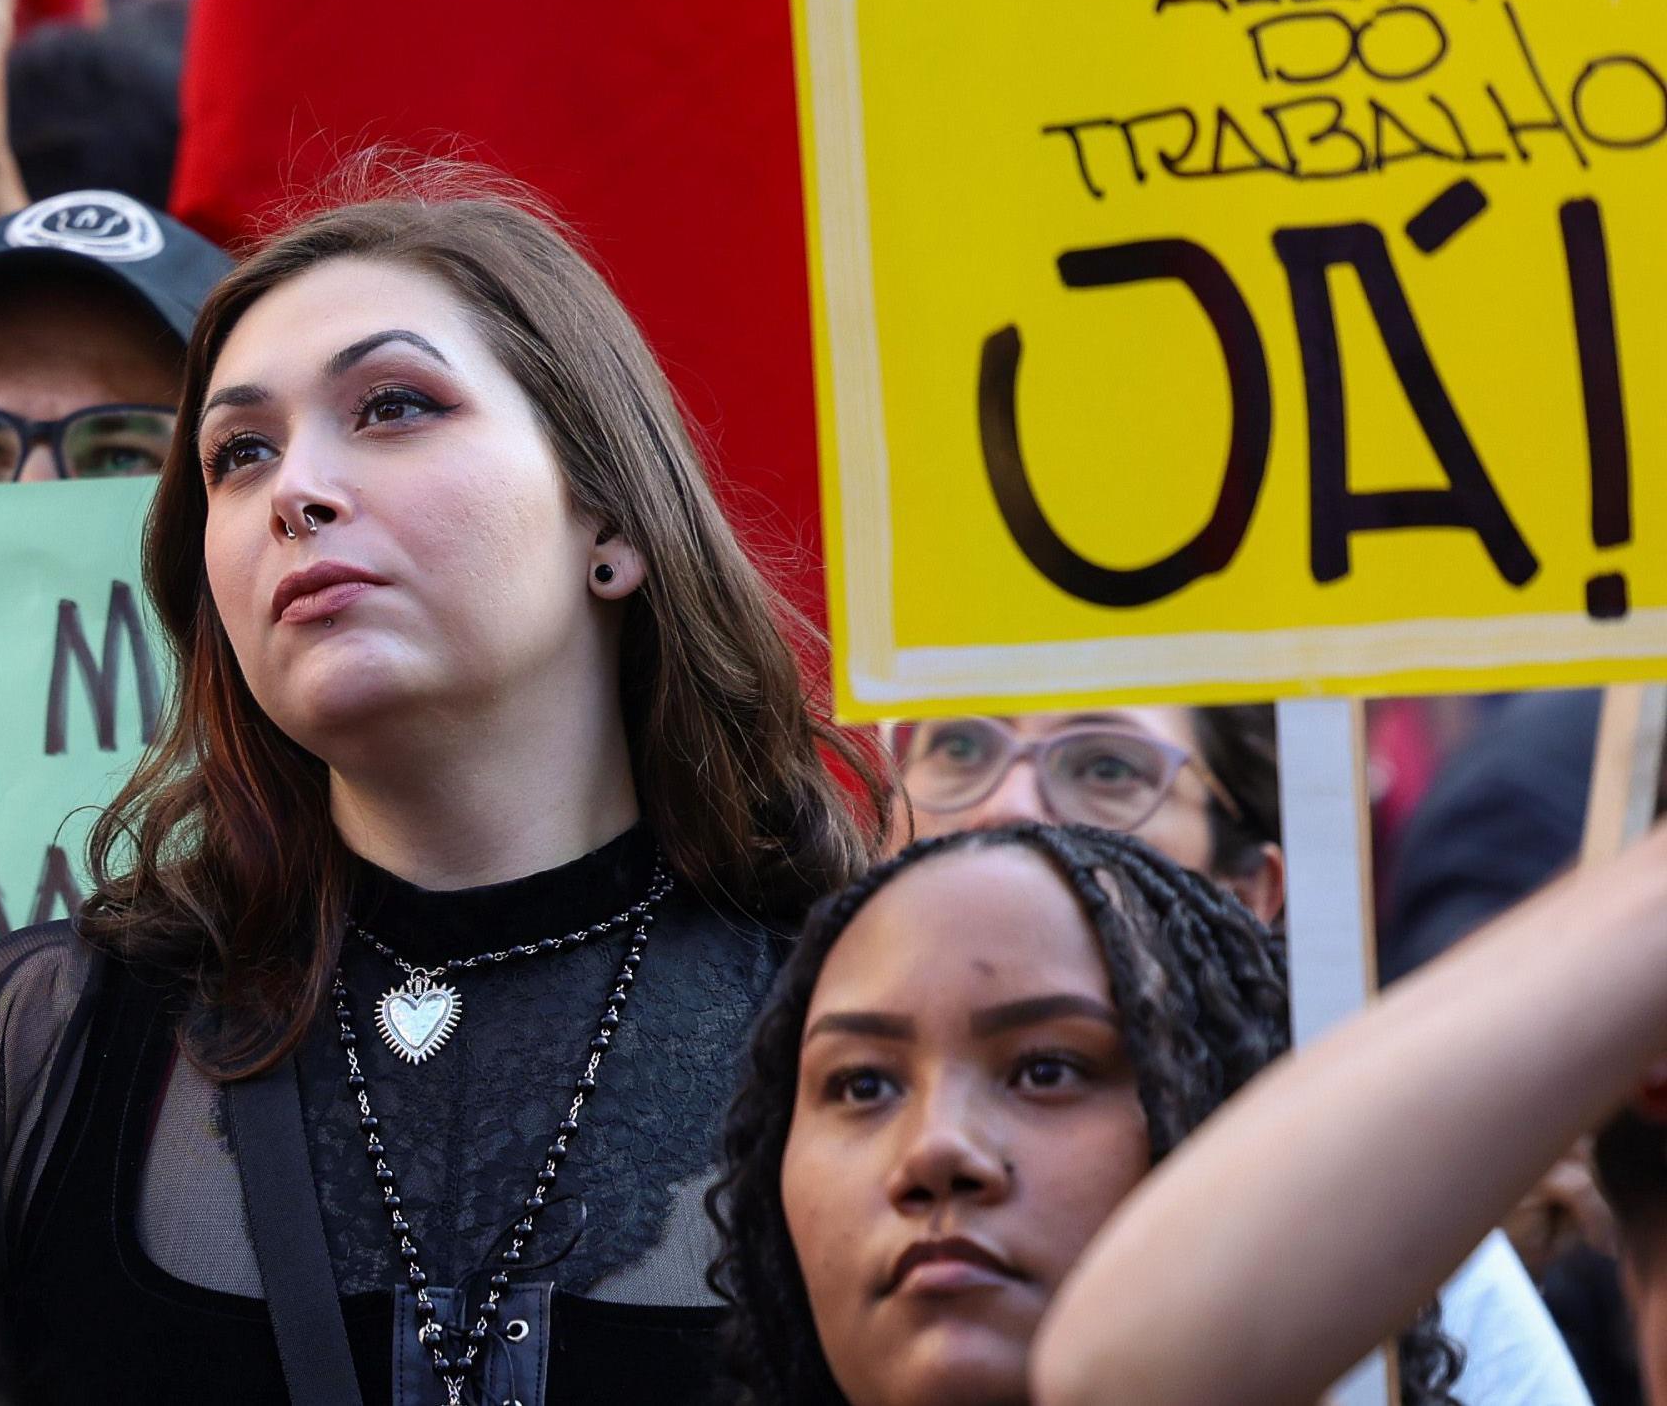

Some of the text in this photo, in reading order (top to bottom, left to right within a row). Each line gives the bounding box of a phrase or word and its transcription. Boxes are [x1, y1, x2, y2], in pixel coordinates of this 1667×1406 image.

[1041, 0, 1667, 198] TRABALHO
[1247, 3, 1449, 82] DO
[977, 176, 1633, 622] JÁ!
